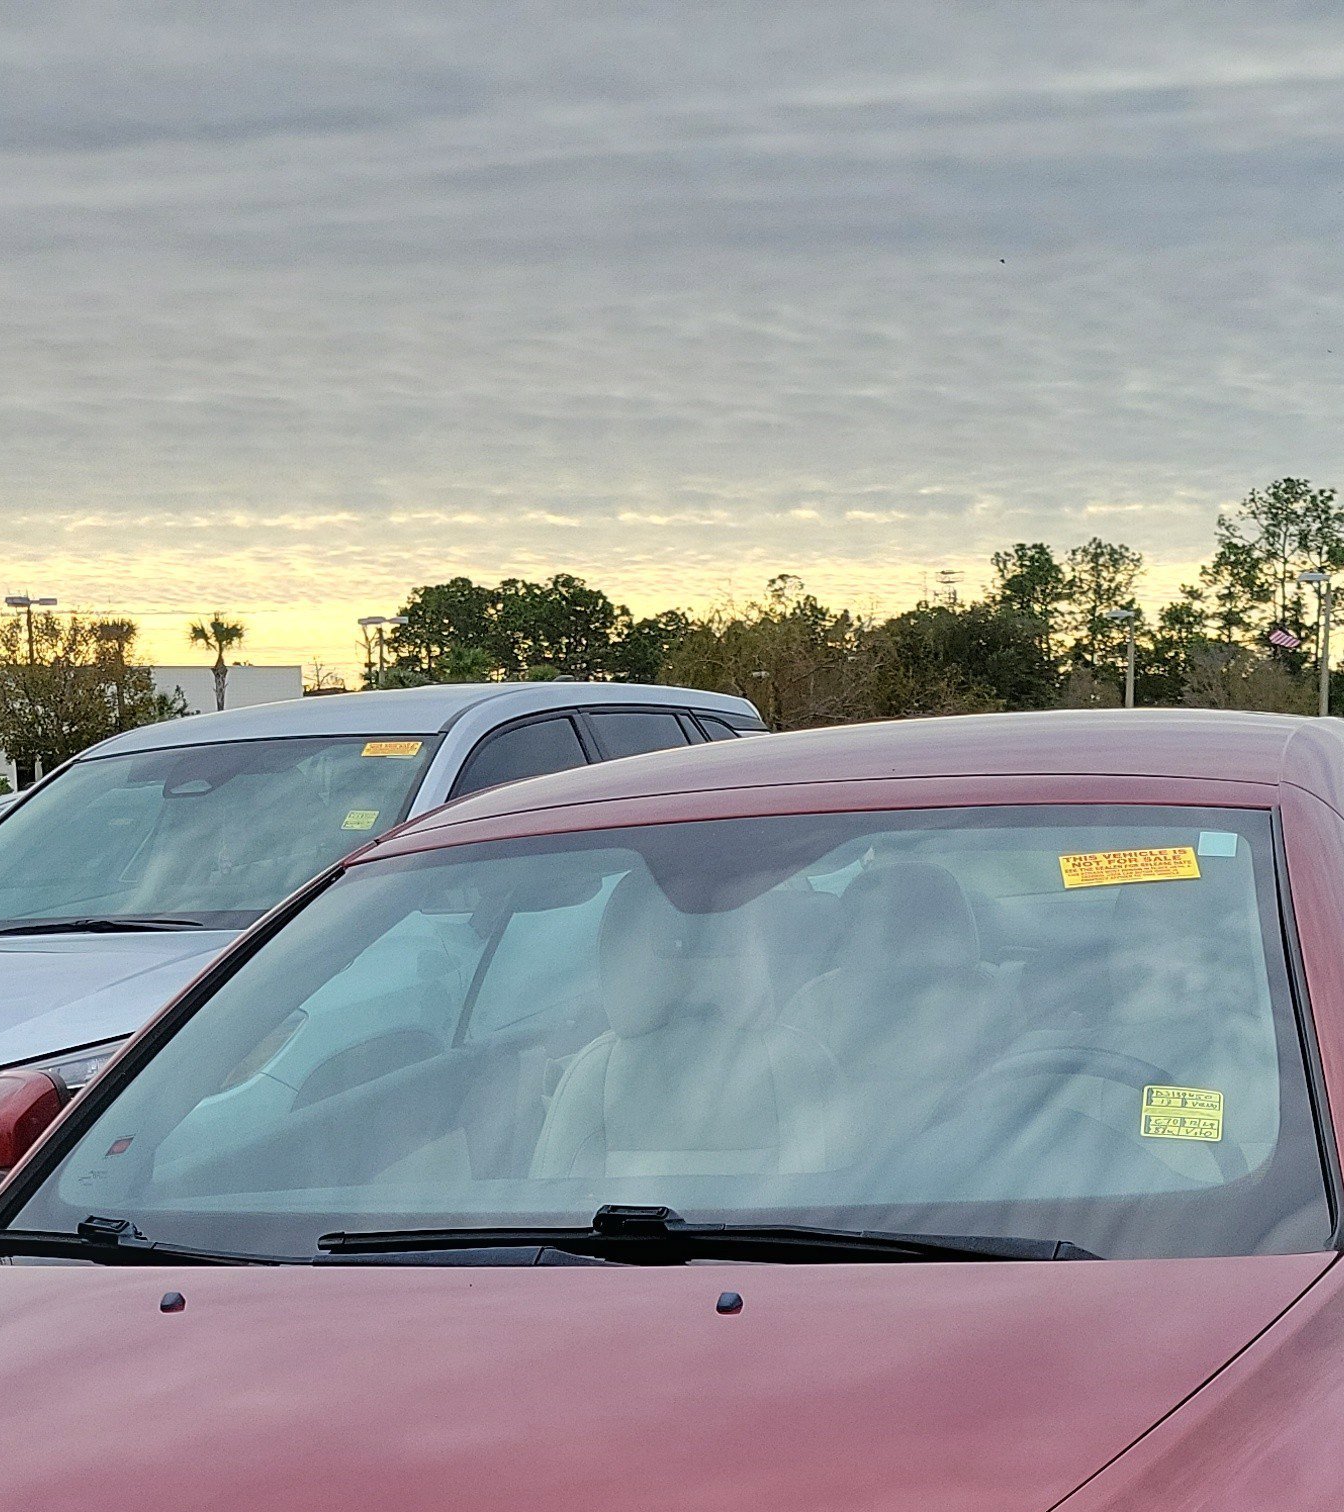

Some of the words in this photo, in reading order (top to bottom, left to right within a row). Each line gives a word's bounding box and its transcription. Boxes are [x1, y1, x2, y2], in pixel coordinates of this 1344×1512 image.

[1063, 854, 1098, 863] THIS
[1102, 849, 1168, 860] VEHICLE
[1172, 848, 1188, 856] IS
[1071, 860, 1103, 868] NOT
[1107, 857, 1138, 865] FOR
[1143, 854, 1182, 863] SALE
